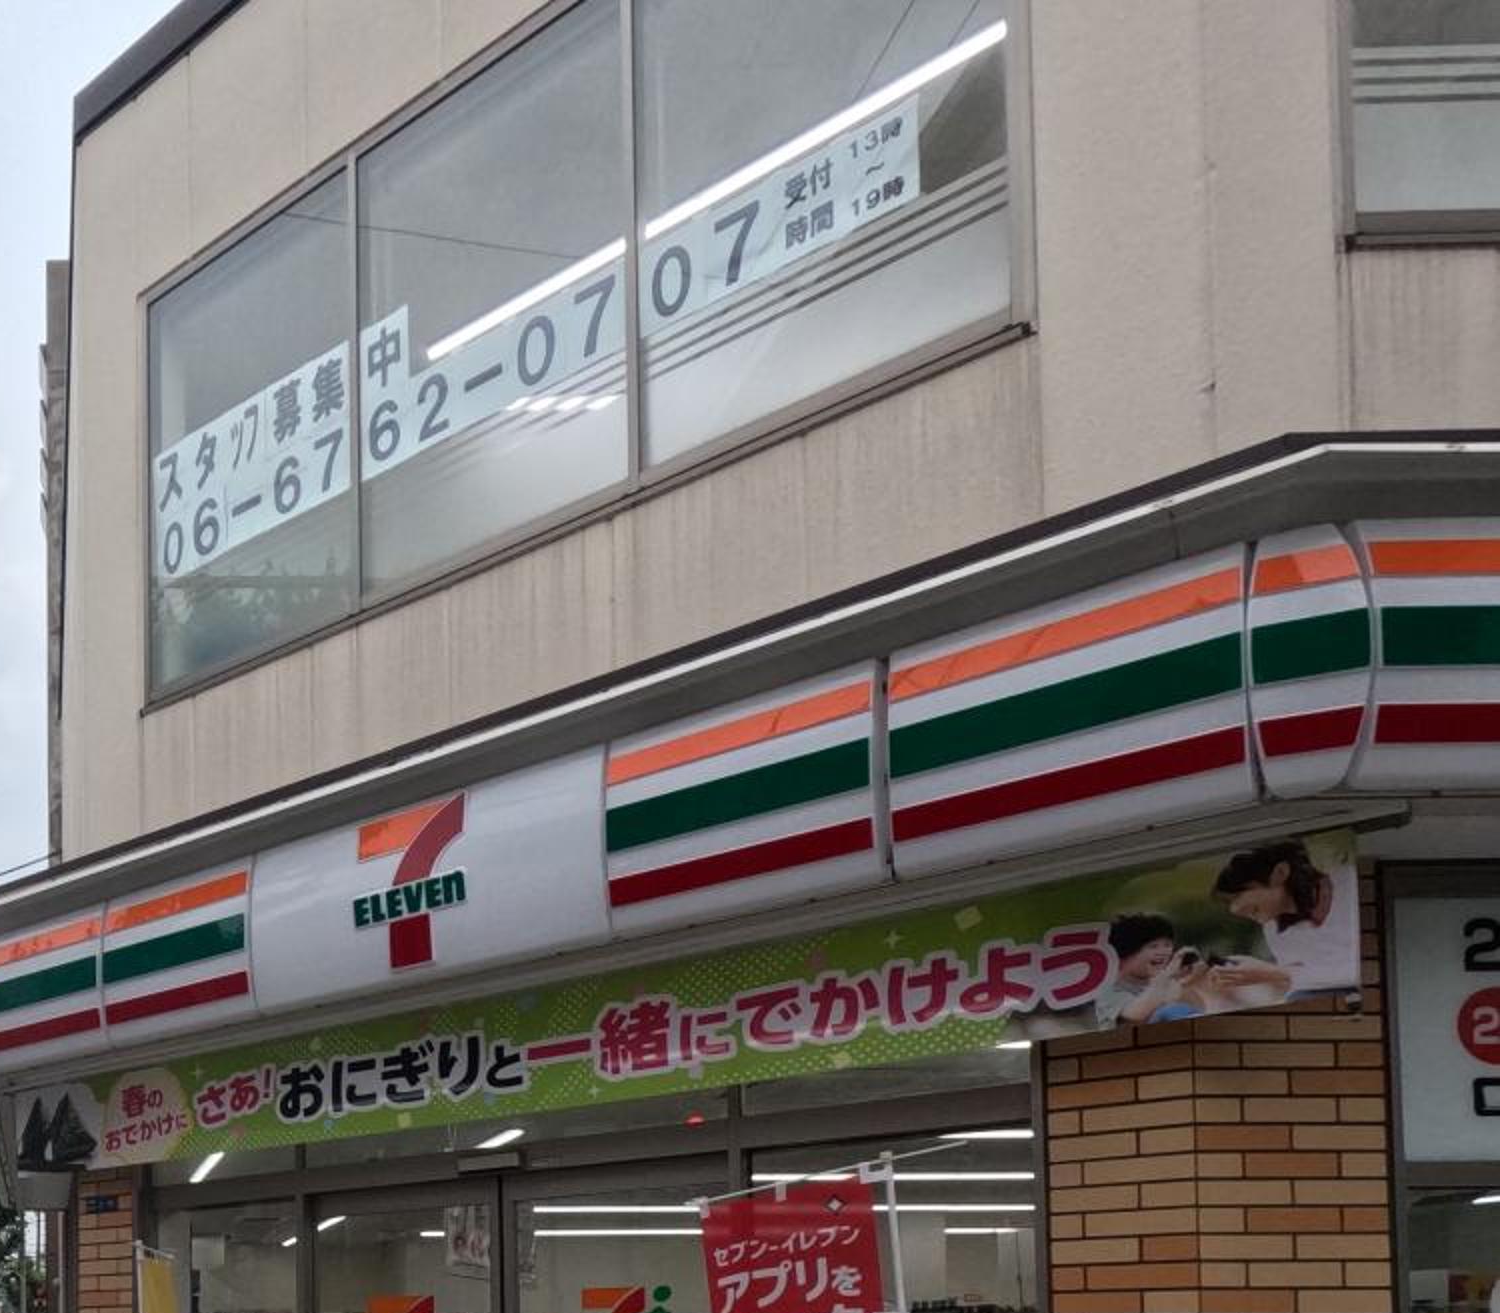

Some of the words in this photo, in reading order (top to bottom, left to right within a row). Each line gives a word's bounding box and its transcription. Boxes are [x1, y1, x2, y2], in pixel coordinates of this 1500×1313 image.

[849, 117, 902, 159] 13時
[784, 161, 834, 206] 受付
[852, 182, 904, 222] 19時
[785, 205, 835, 250] 時間
[158, 327, 403, 512] スタッフ募集中
[121, 1082, 163, 1113] 春の
[104, 1113, 190, 1153] おでかけに
